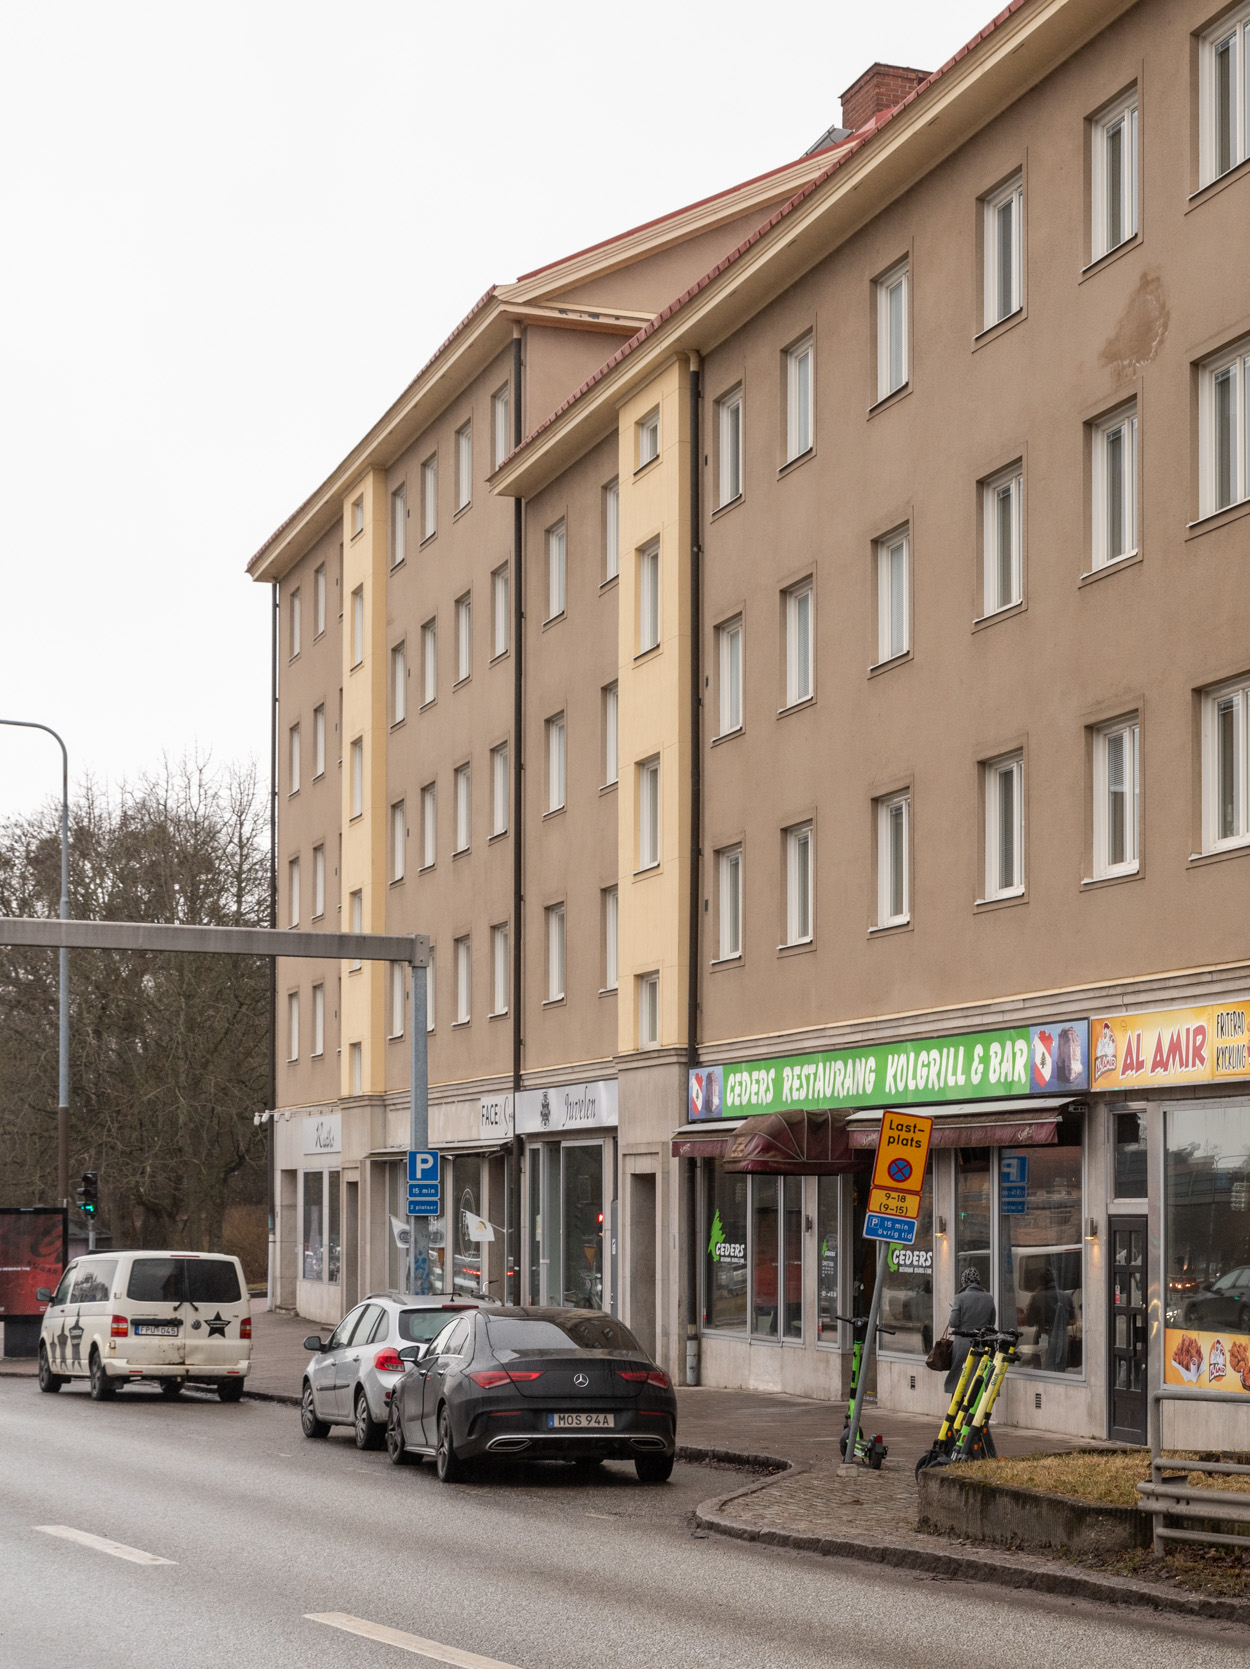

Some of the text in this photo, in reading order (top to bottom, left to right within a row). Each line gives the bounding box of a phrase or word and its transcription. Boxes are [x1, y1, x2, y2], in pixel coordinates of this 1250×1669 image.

[1216, 1010, 1246, 1039] FRITERAD
[1120, 1022, 1208, 1079] AL AMIR
[1216, 1043, 1246, 1072] KYCKLING
[726, 1038, 1028, 1107] CEDERS RESTAURANG KOLGRILL & BAR
[482, 1103, 498, 1126] FACE
[562, 1085, 597, 1128] Juvelen
[889, 1119, 925, 1134] Last-
[887, 1134, 922, 1148] plats
[416, 1153, 434, 1179] P
[884, 1192, 907, 1203] 9-18
[879, 1203, 908, 1216] (9-15)
[878, 1228, 899, 1239] övrig
[715, 1243, 745, 1257] CEDERS
[893, 1250, 933, 1267] CEDERS
[141, 1326, 176, 1335] FPU 045
[558, 1415, 609, 1426] MOS 94A
